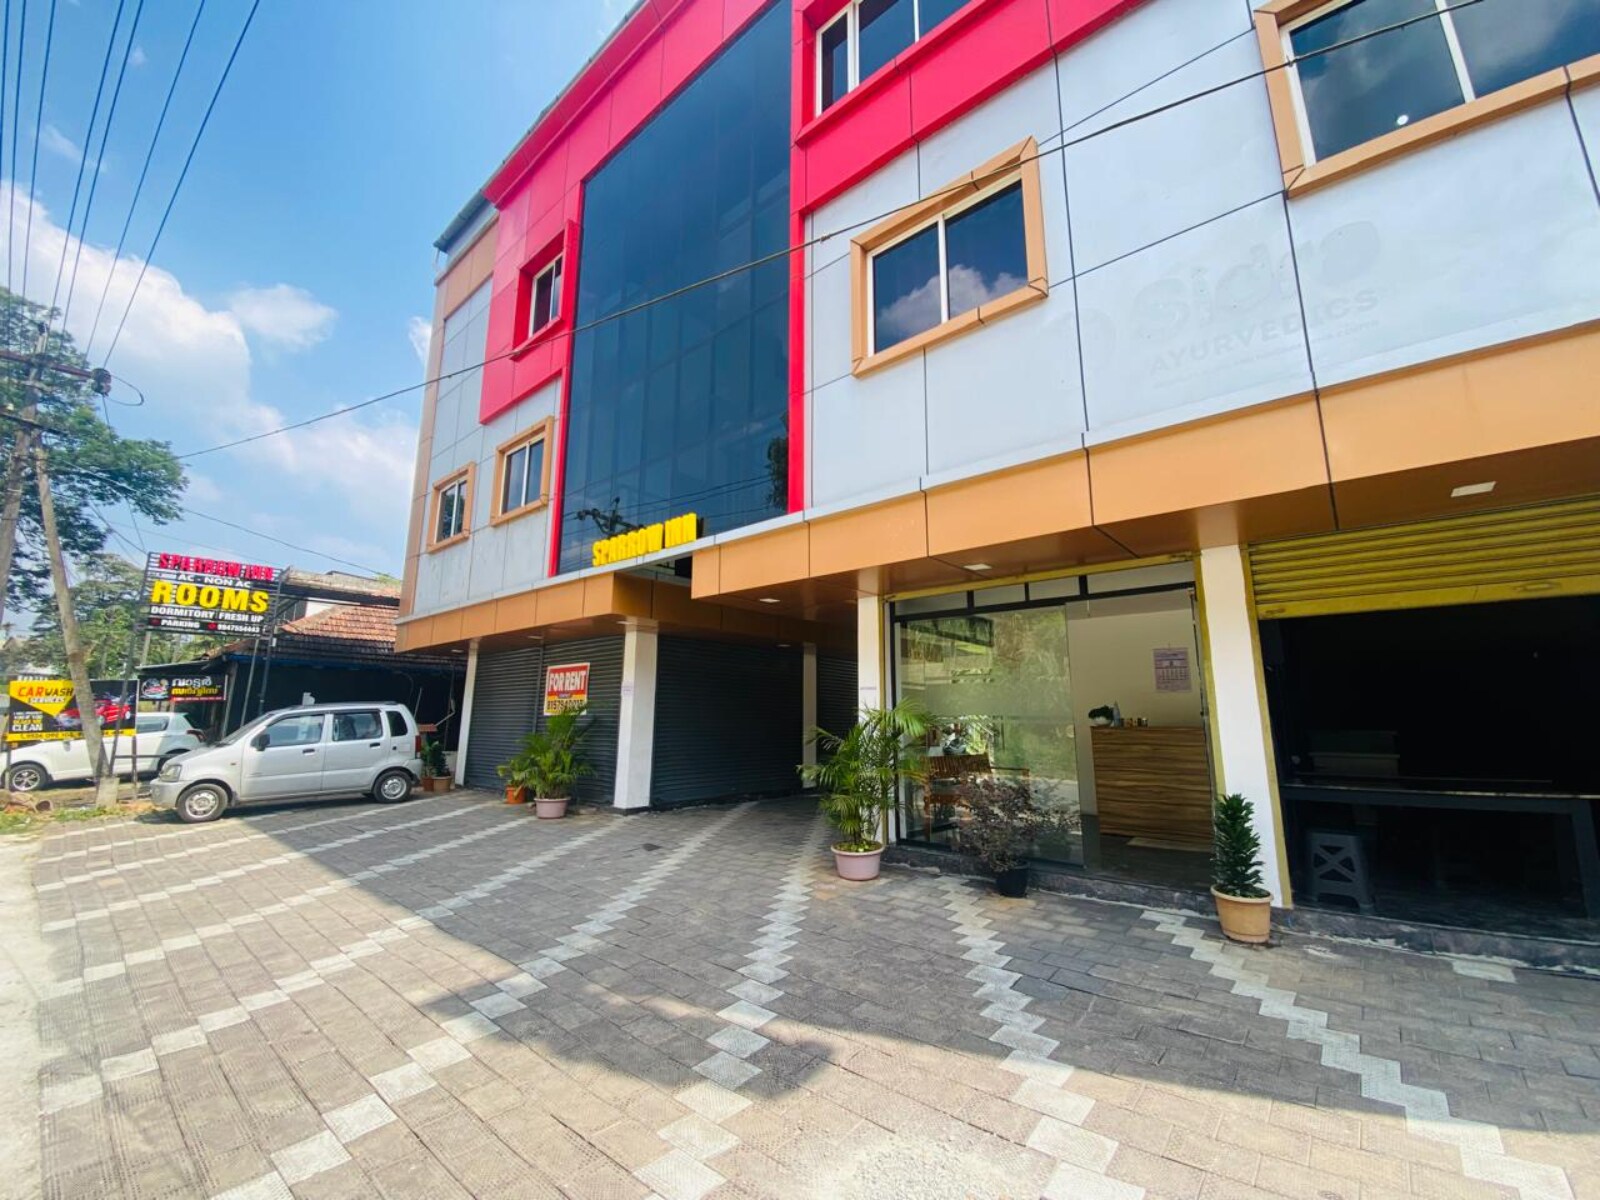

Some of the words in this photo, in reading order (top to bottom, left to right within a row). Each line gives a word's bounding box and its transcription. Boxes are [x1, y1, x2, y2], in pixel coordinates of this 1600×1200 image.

[592, 522, 663, 567] SPARROW
[664, 512, 697, 548] INN
[159, 553, 241, 576] SPARROW
[178, 573, 195, 582] AC
[204, 576, 233, 586] NON
[234, 580, 251, 588] AC
[150, 580, 269, 613] ROOMS
[150, 606, 215, 619] DORMITORY
[218, 612, 249, 621] FRESH
[251, 614, 264, 623] UP
[161, 619, 200, 629] PARKING
[549, 672, 565, 692] FOR
[565, 670, 587, 690] RENT
[12, 724, 43, 732] CLEAN
